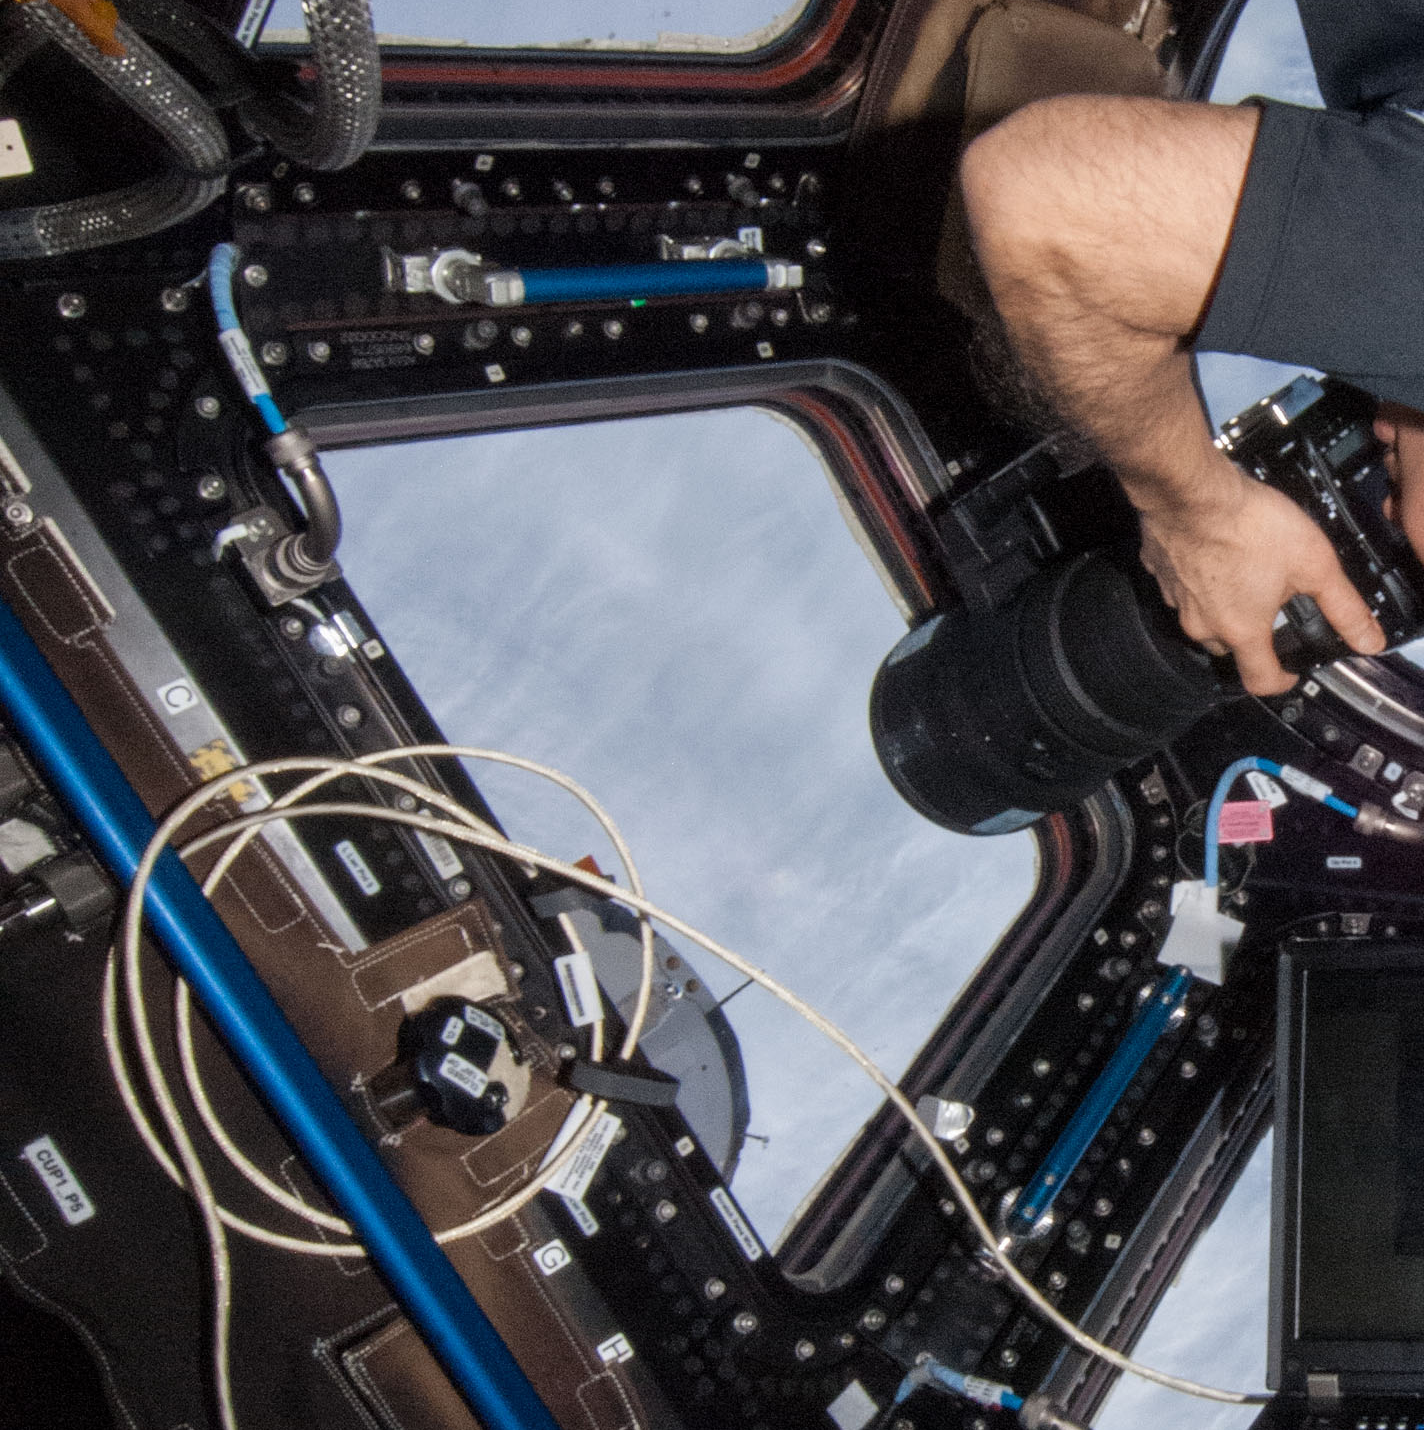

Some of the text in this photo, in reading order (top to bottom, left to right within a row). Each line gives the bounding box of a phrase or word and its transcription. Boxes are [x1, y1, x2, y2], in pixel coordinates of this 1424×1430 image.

[164, 685, 193, 708] C
[36, 1149, 84, 1215] CUP1_P5
[541, 1245, 567, 1269] G
[602, 1338, 631, 1363] H
